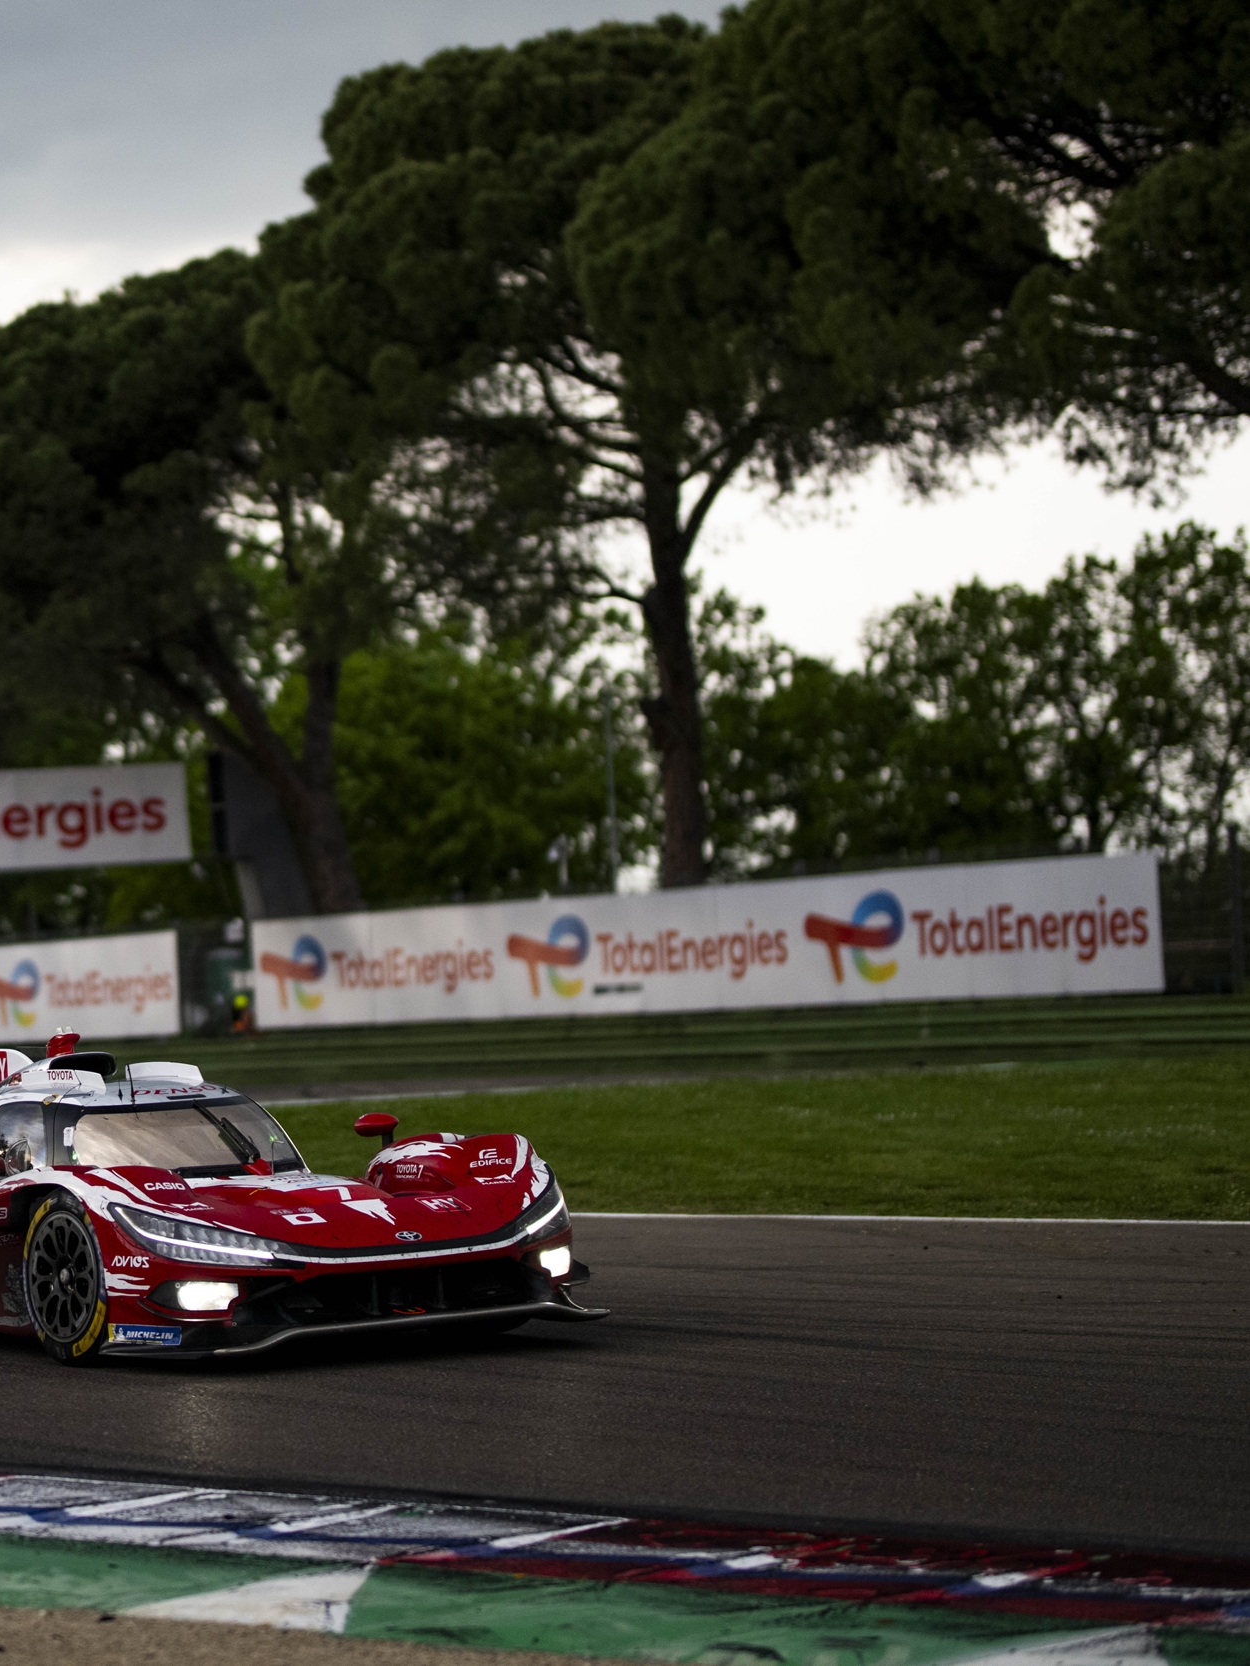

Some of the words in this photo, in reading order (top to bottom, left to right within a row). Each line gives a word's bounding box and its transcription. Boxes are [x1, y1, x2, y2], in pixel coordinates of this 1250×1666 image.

[910, 895, 1149, 964] TotalEnergies
[596, 918, 789, 981] TotalEnergies
[330, 938, 495, 994] TotalEnergies
[47, 1070, 74, 1081] TOYOTA
[132, 1084, 218, 1096] DENSO
[470, 1158, 513, 1168] EDIFICE
[395, 1164, 418, 1174] TOYOTA
[417, 1164, 424, 1179] 7
[143, 1181, 186, 1191] CASIO
[316, 1186, 352, 1201] 7
[125, 1330, 175, 1340] MICHELIN
